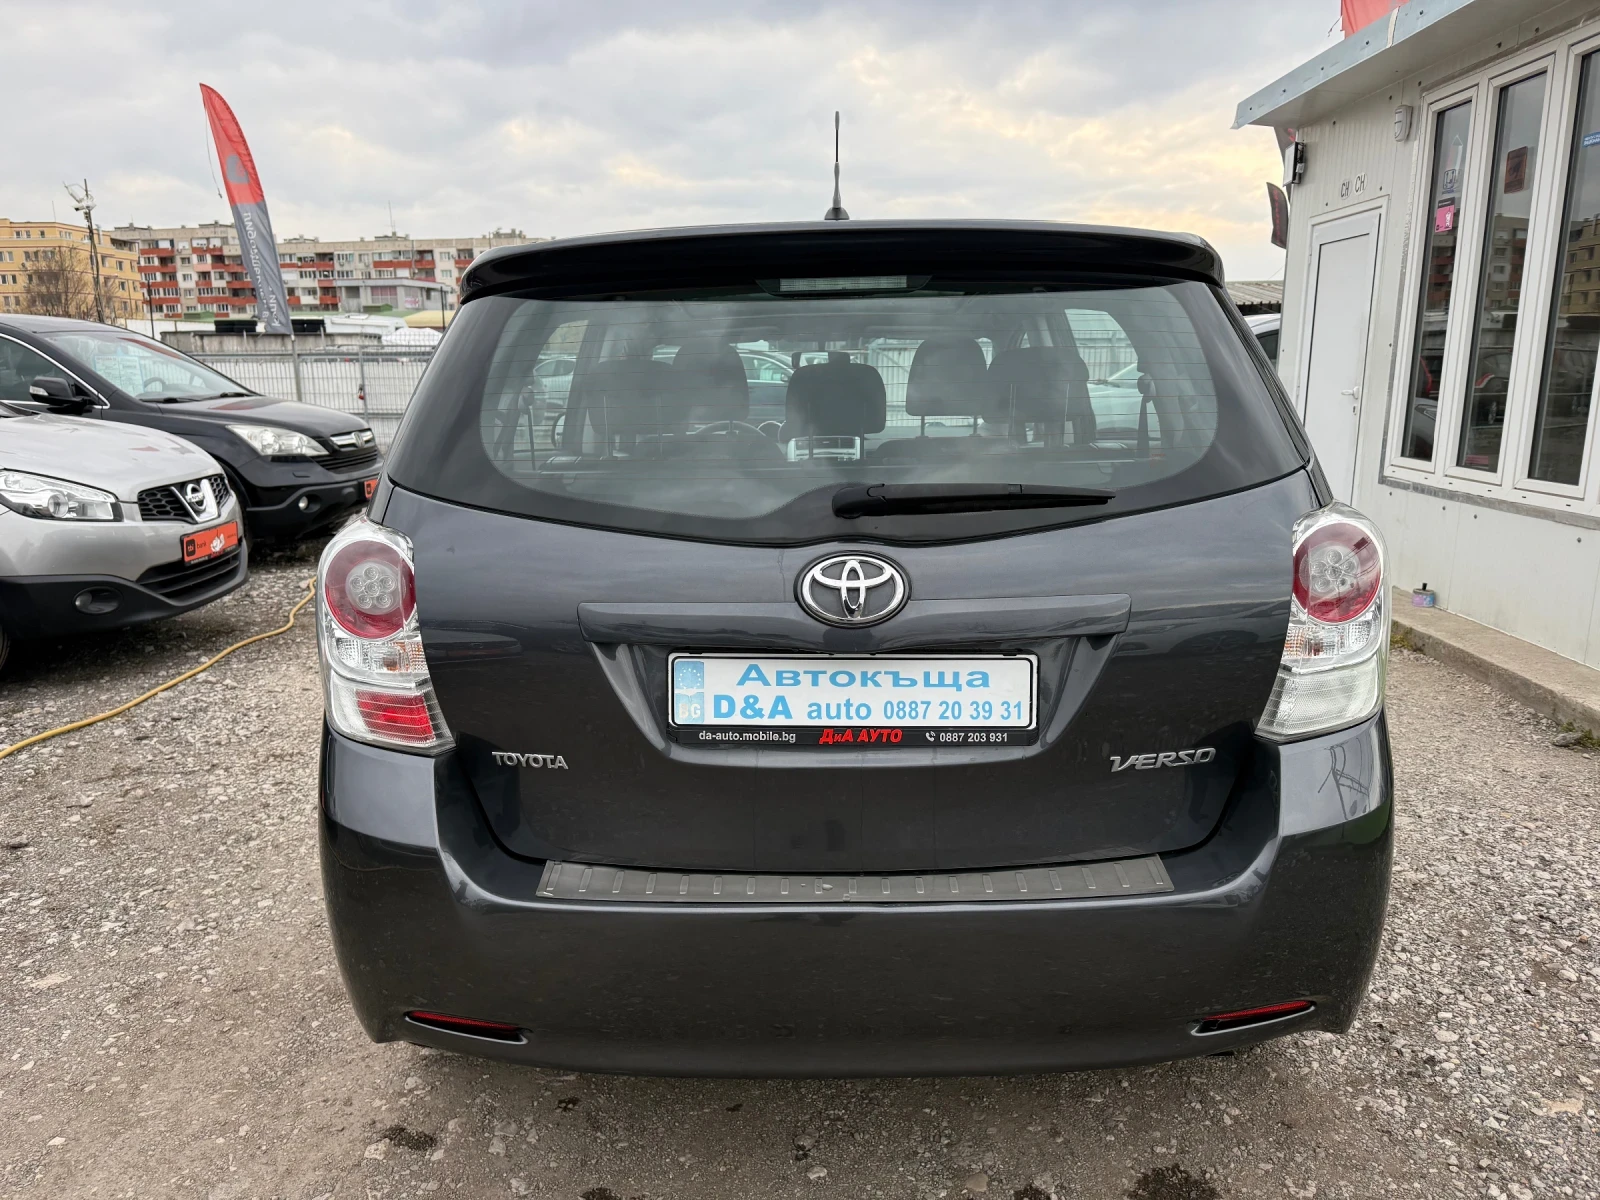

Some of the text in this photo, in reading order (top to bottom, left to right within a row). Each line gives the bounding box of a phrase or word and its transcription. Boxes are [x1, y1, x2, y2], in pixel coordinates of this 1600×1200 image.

[736, 663, 990, 692] Автокъща
[678, 703, 701, 719] BG
[713, 694, 1023, 721] D&A auto 0887 20 39 31
[699, 730, 796, 744] da-auto.mobile.bg
[818, 728, 903, 745] ДиА АУТО
[939, 732, 1008, 743] 0887 203 931
[491, 751, 569, 770] TOYOTA
[1109, 747, 1216, 772] VERSO
